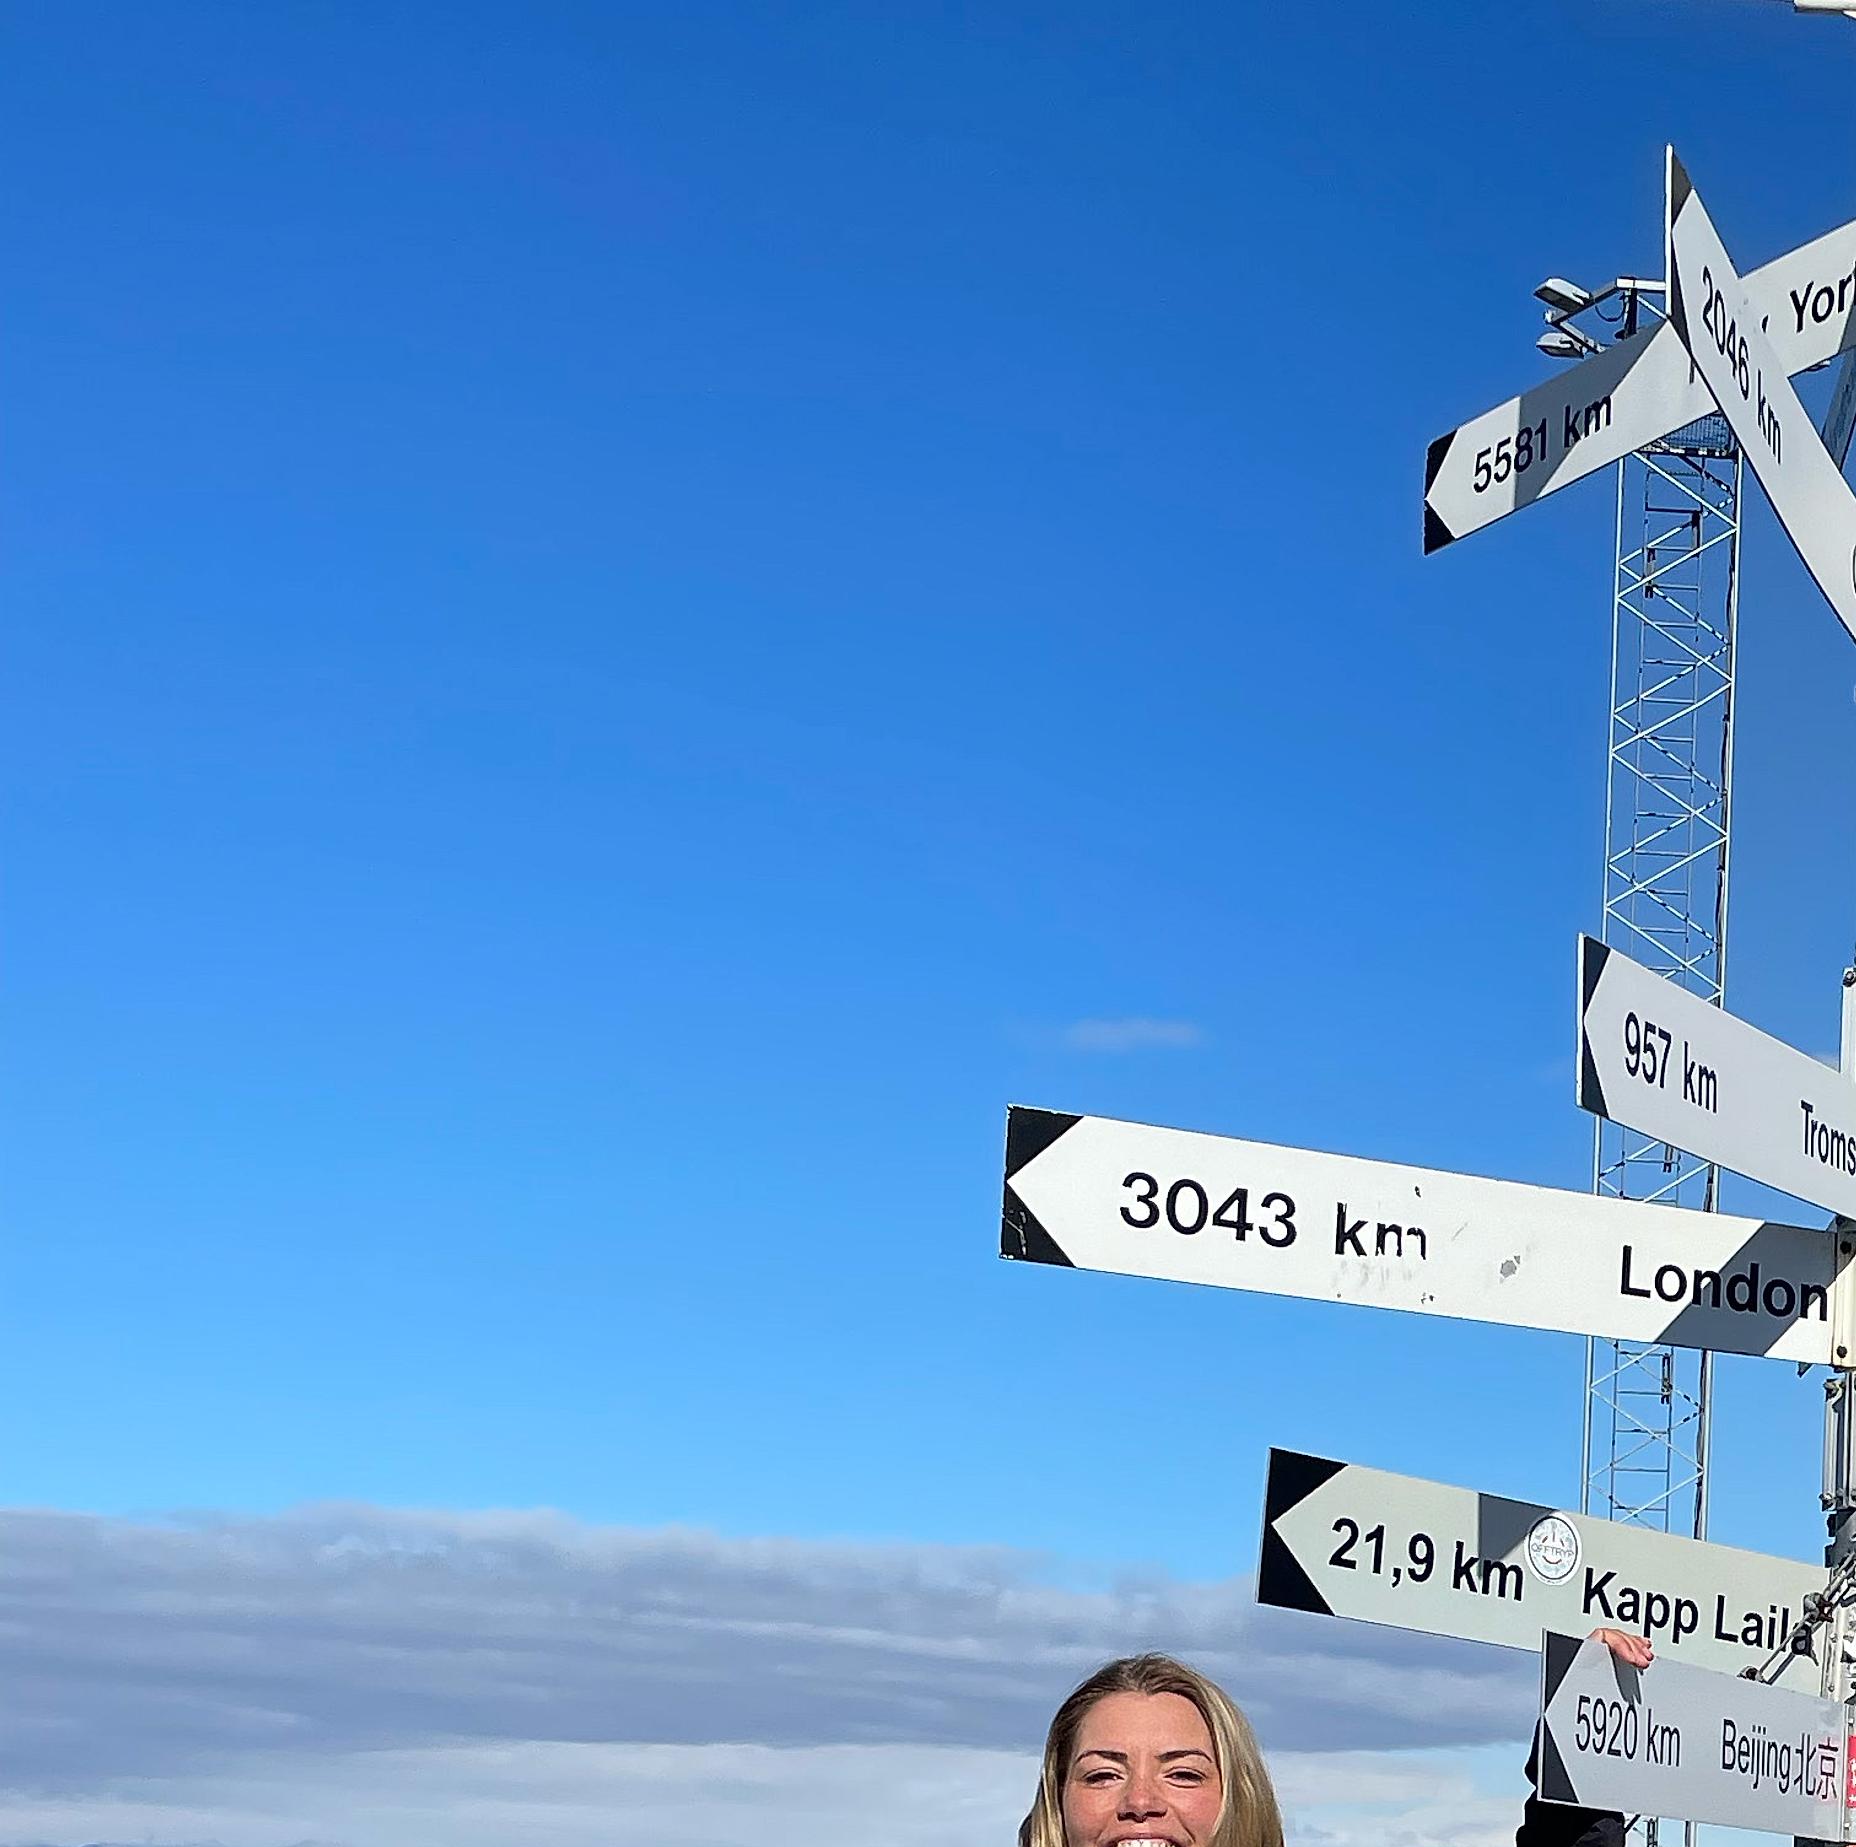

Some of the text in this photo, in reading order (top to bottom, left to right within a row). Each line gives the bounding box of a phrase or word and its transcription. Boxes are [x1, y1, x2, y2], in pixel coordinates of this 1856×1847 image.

[1702, 266, 1750, 401] 2046
[1757, 367, 1782, 465] km
[1473, 394, 1613, 493] 5581 km
[1623, 1011, 1673, 1087] 957
[1682, 1040, 1718, 1114] km
[1118, 1170, 1828, 1323] 3043 km London
[1328, 1517, 1435, 1590] 21,9
[1452, 1541, 1524, 1602] km
[1581, 1566, 1699, 1645] Kapp
[1574, 1695, 1840, 1801] 5920 km Beijing 北京
